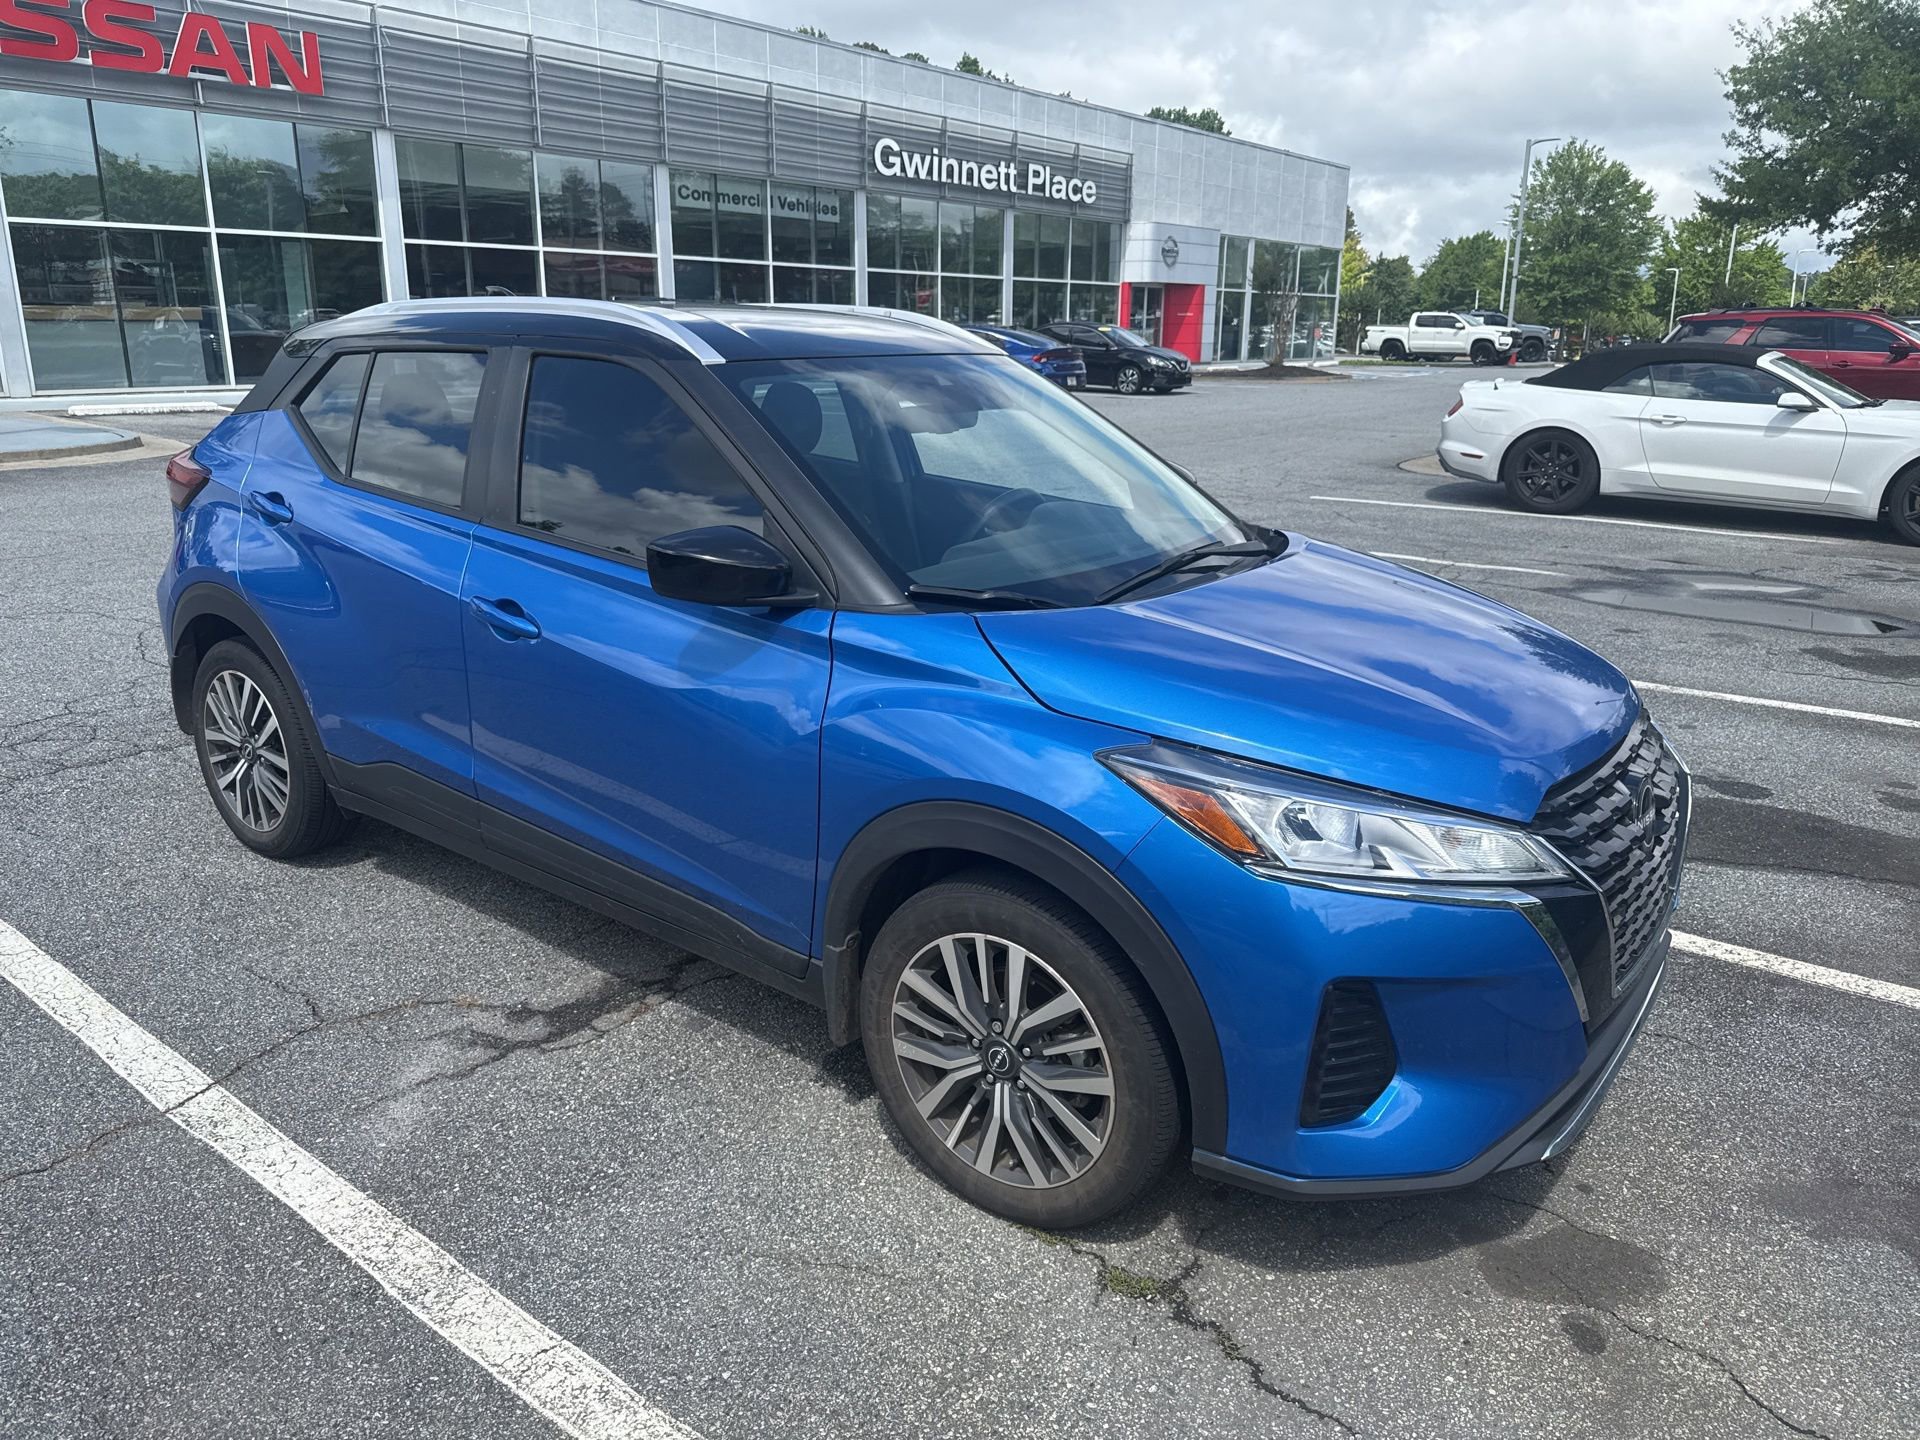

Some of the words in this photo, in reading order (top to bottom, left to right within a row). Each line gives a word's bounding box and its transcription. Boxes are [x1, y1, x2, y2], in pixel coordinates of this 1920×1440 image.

[874, 137, 1018, 193] Gwinnett
[1027, 162, 1098, 205] Place
[677, 184, 774, 209] Commercil
[777, 195, 838, 216] Vehiles
